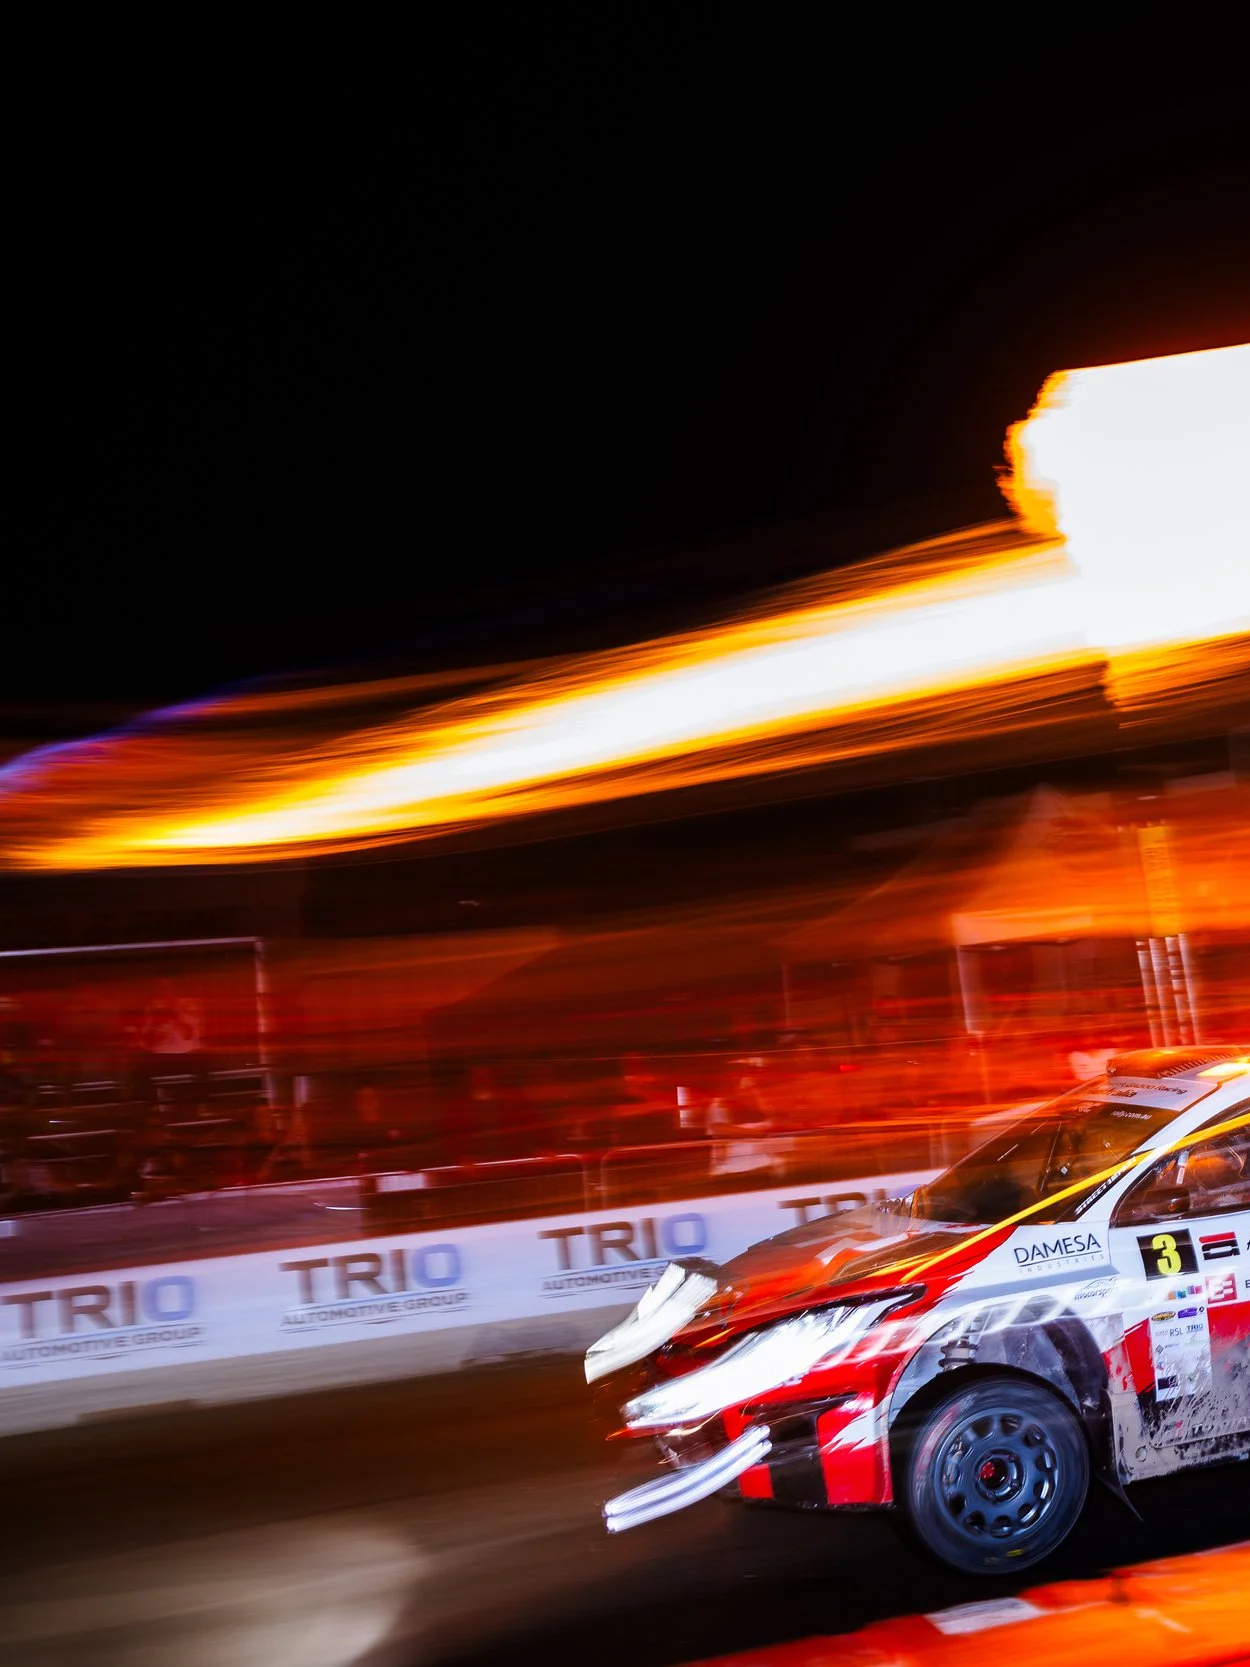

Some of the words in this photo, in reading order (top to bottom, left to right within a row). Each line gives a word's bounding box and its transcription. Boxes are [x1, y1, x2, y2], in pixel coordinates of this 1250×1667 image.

[538, 1213, 708, 1270] TRIO
[1014, 1233, 1102, 1264] DAMESA
[1152, 1234, 1182, 1275] 3
[279, 1243, 462, 1304] TRIO
[542, 1267, 651, 1291] AUTOMOTIVE
[1019, 1253, 1104, 1274] INDUSTRIES
[0, 1275, 196, 1339] TRIO
[281, 1302, 399, 1325] AUTOMOTIVE
[403, 1292, 469, 1310] GROUP
[1170, 1327, 1183, 1337] RSL
[1187, 1323, 1203, 1331] TRIO
[1, 1336, 127, 1362] AUTOMOTIVE
[131, 1326, 203, 1346] GROUP
